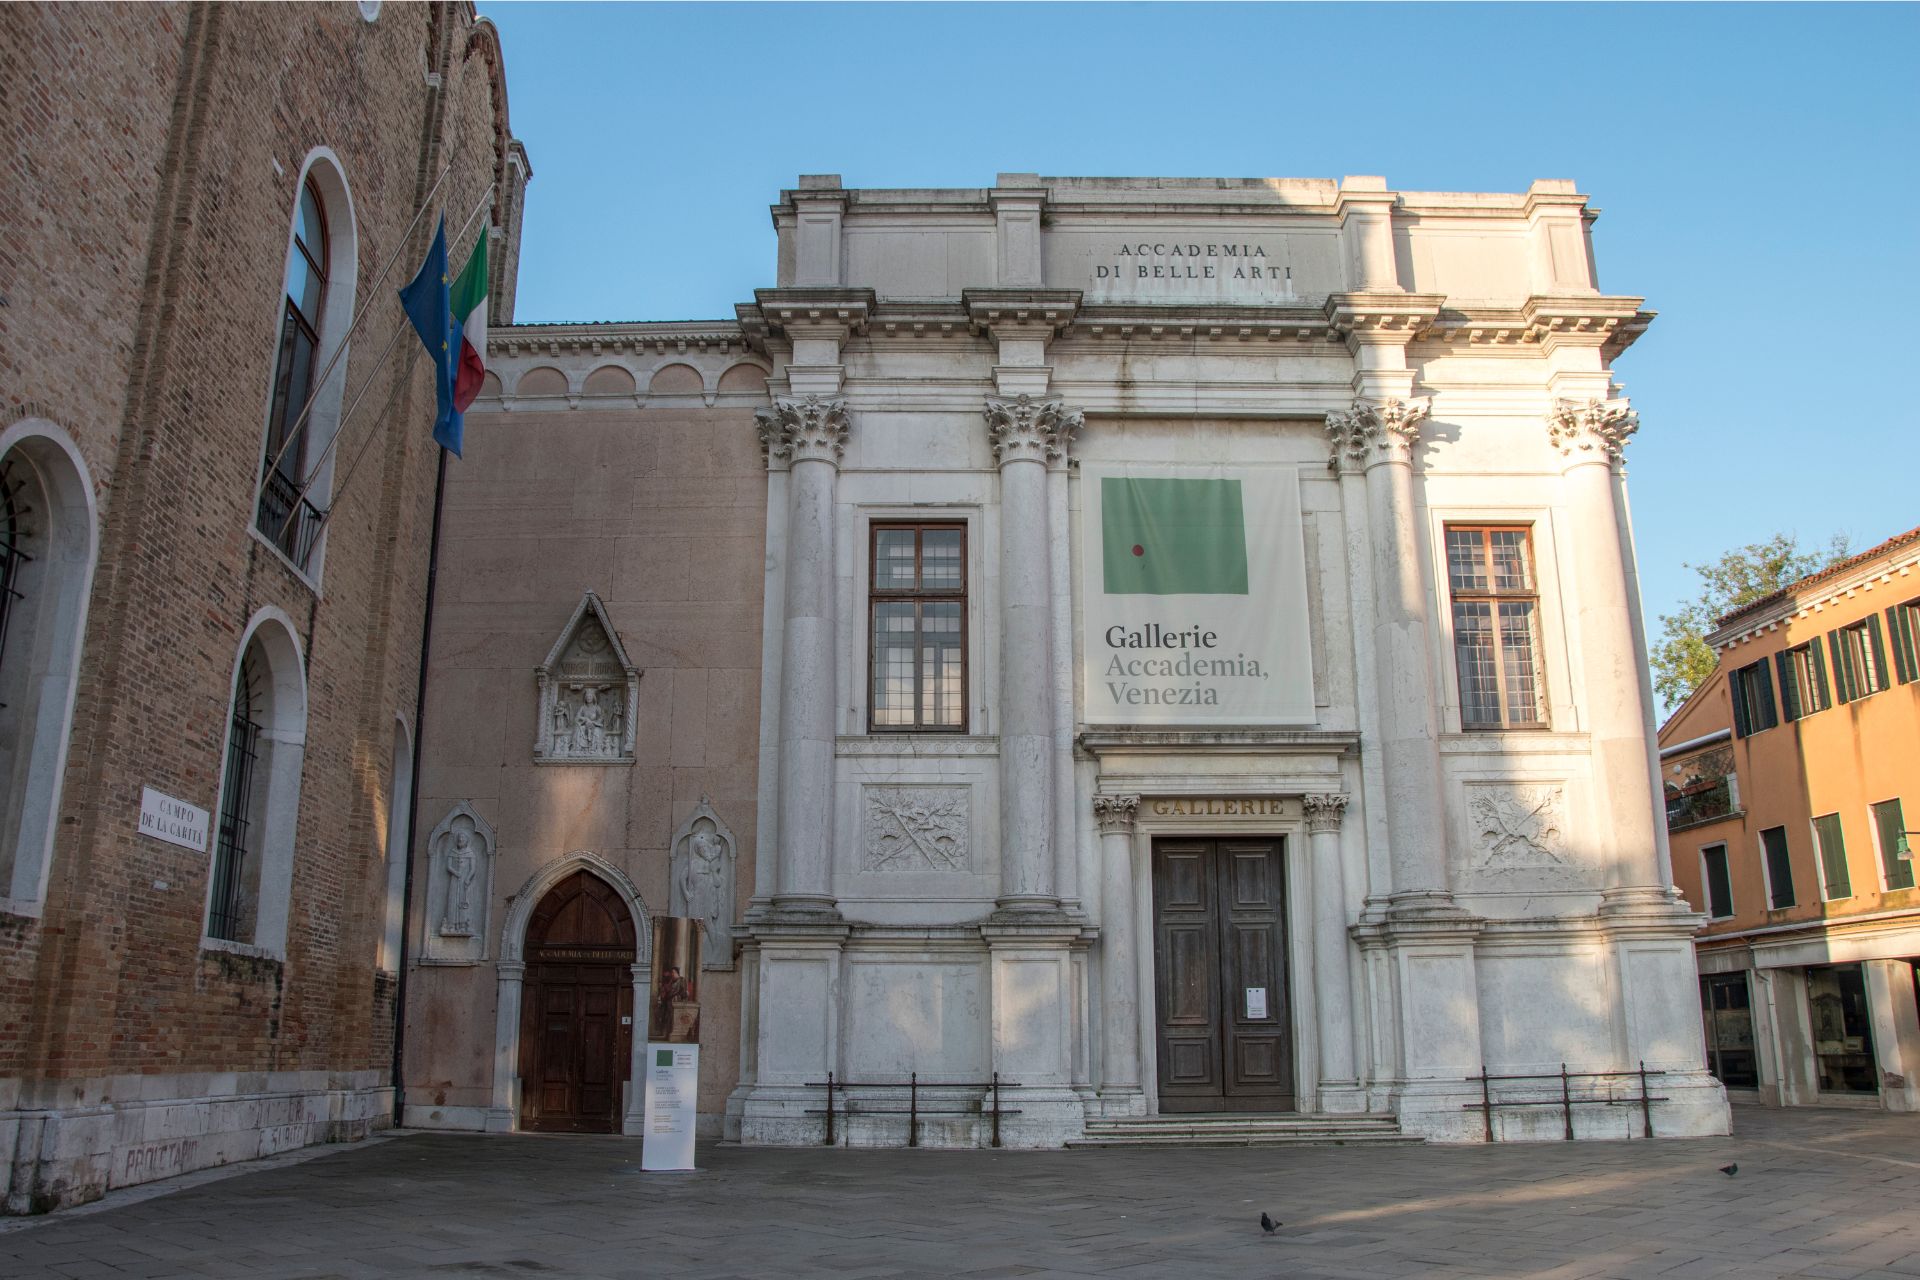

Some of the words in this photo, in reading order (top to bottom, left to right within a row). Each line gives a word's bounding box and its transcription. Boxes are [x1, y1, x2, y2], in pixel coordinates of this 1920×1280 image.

[1121, 244, 1266, 257] ACCADEMIA
[1096, 265, 1121, 278] DI
[1138, 265, 1215, 279] BELLE
[1233, 266, 1292, 279] ARTI
[1105, 623, 1218, 648] Gallerie
[1104, 651, 1270, 680] Accademia,
[1106, 681, 1219, 705] Venezia
[160, 799, 194, 823] CAMPO
[1152, 800, 1284, 815] GALLERIE
[141, 812, 155, 828] DE
[156, 817, 167, 833] LA
